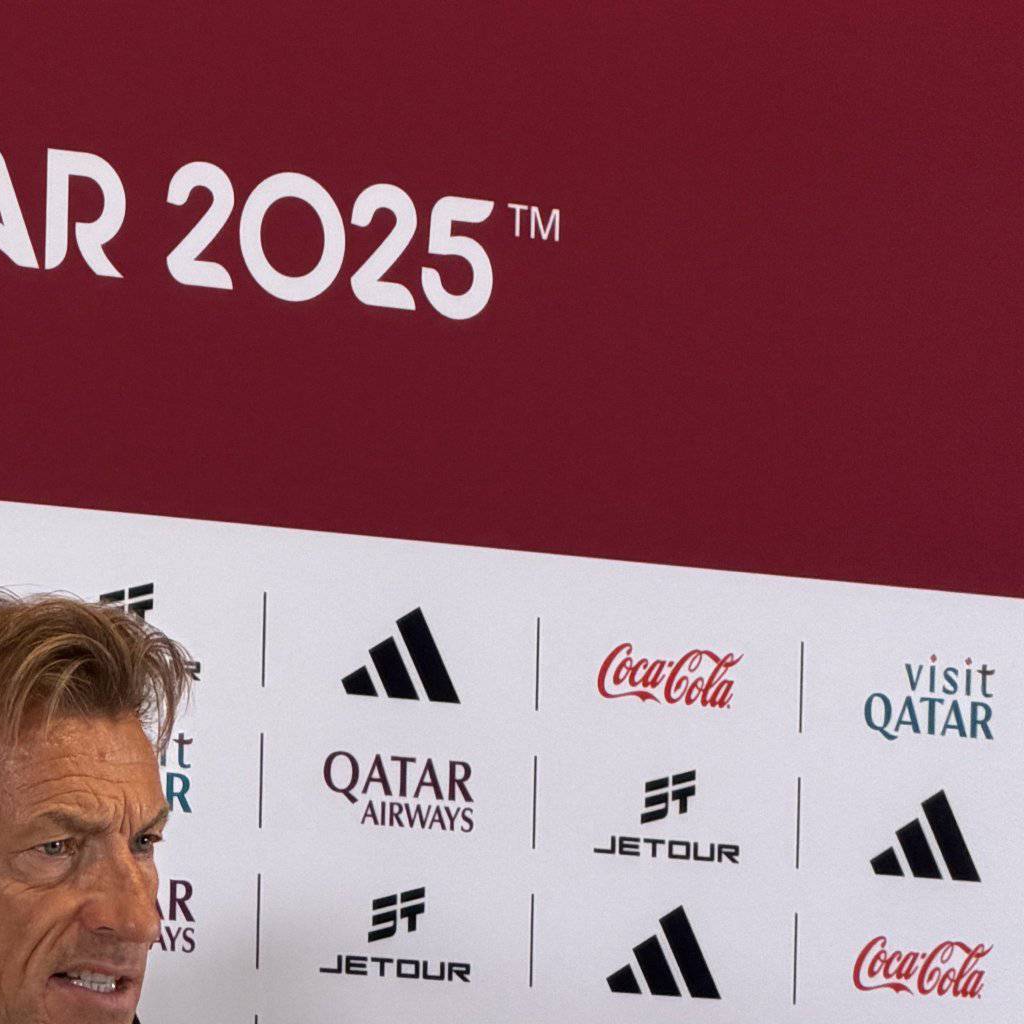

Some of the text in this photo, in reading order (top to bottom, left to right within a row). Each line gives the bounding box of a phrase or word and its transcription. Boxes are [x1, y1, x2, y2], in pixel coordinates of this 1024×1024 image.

[598, 643, 743, 708] Coca-Cola
[905, 654, 995, 697] visit
[864, 692, 993, 740] QATAR
[324, 751, 473, 803] QATAR
[361, 799, 473, 832] AIRWAYS
[594, 836, 739, 864] JETOUR
[320, 955, 470, 982] JETOUR
[853, 936, 993, 999] Coca-Cola
